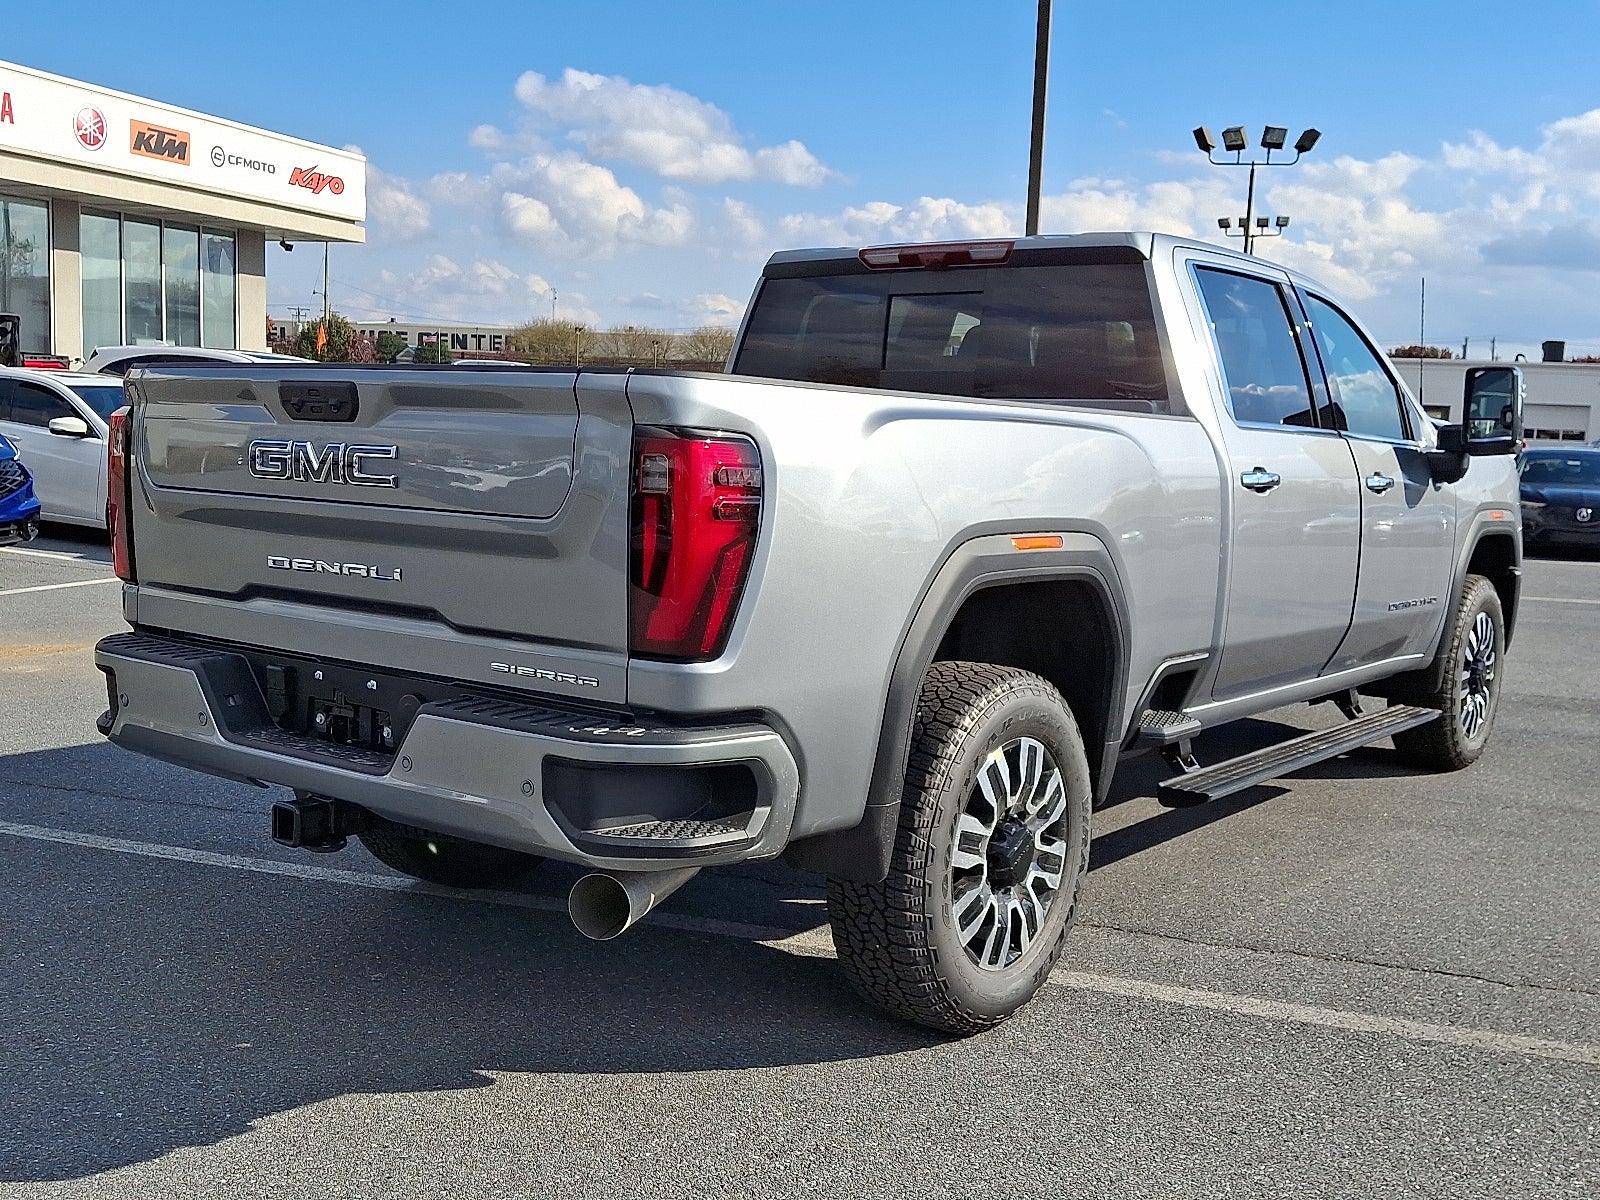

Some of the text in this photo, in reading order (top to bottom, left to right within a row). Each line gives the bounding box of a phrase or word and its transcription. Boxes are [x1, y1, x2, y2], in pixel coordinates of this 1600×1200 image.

[132, 127, 188, 160] KTM
[227, 154, 276, 174] CFMOTO
[417, 331, 518, 351] CENTE
[248, 439, 399, 488] GMC
[267, 555, 402, 583] DENALI
[490, 661, 600, 688] SIERRA
